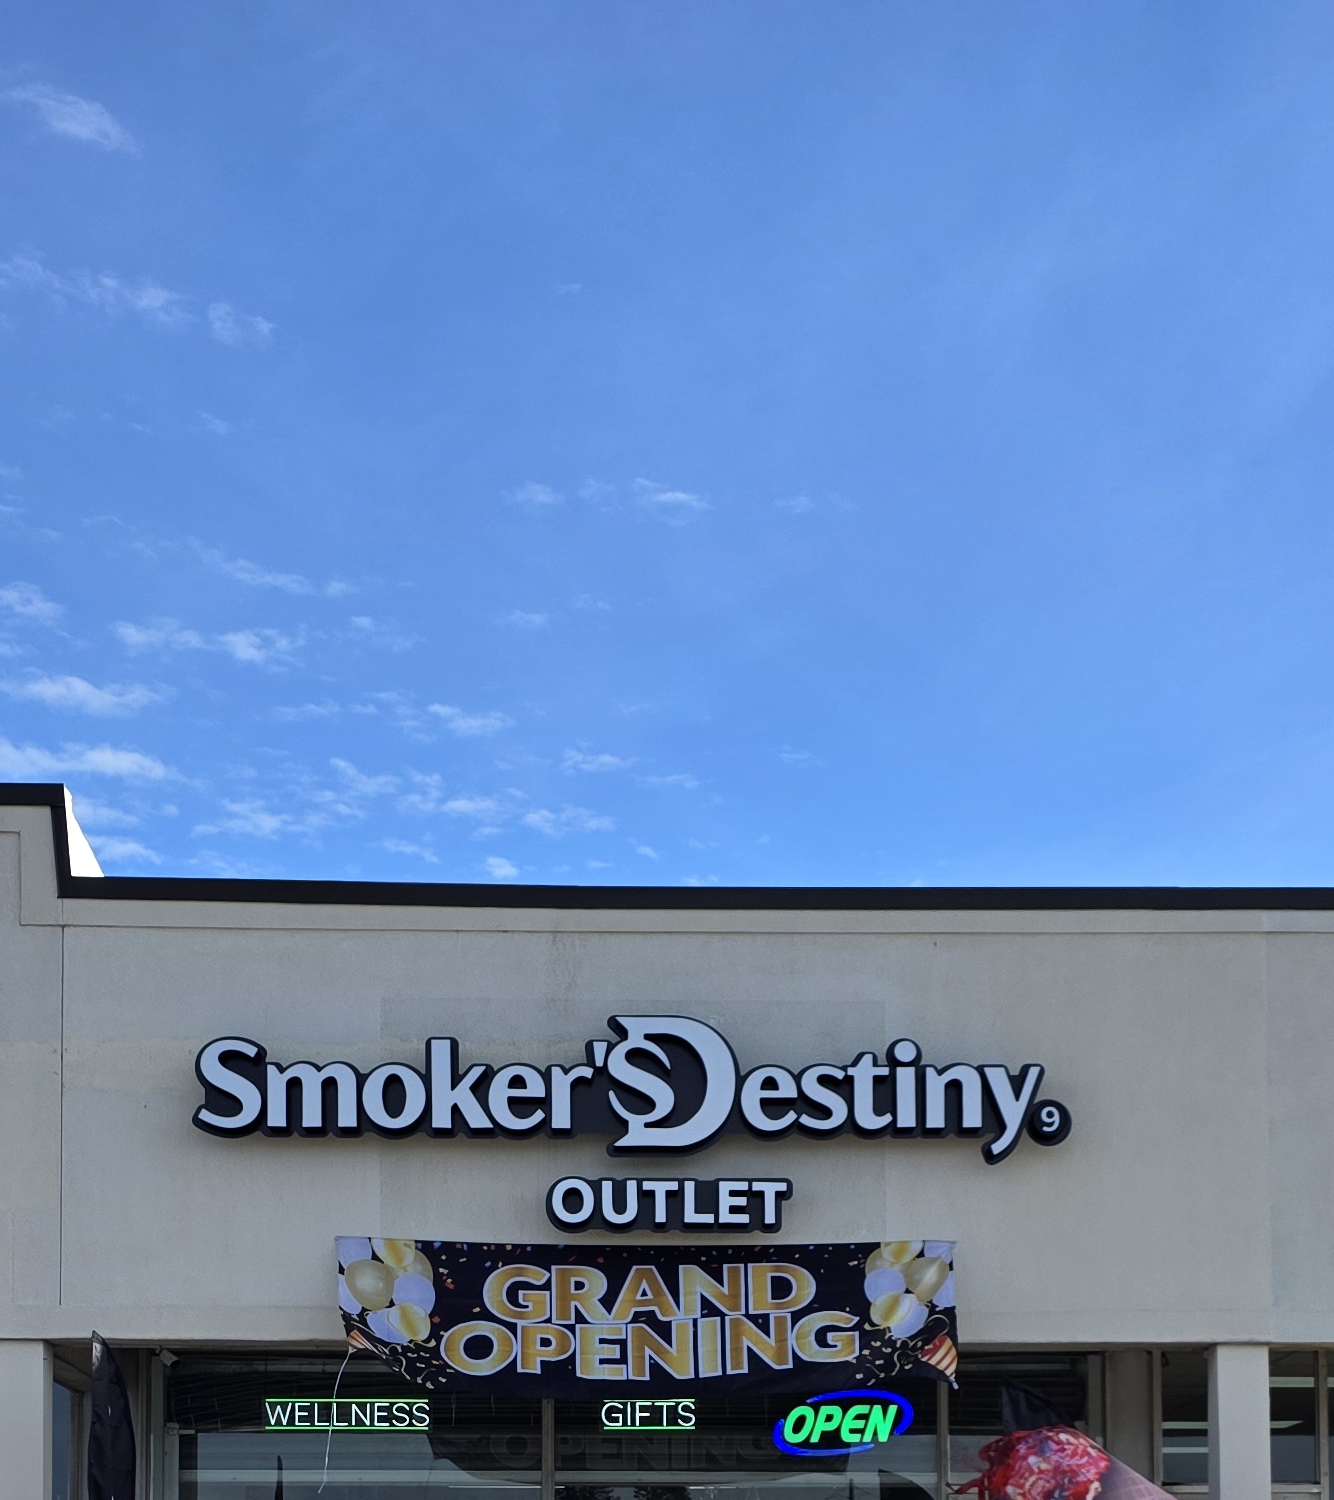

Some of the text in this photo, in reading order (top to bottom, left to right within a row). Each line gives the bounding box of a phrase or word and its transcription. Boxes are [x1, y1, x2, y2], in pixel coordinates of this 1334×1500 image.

[551, 1177, 788, 1226] OUTLET
[482, 1261, 816, 1325] GRAND
[440, 1310, 859, 1380] OPENING
[266, 1402, 430, 1427] WELLNESS
[601, 1402, 696, 1427] GIFTS
[783, 1404, 898, 1444] OPEN
